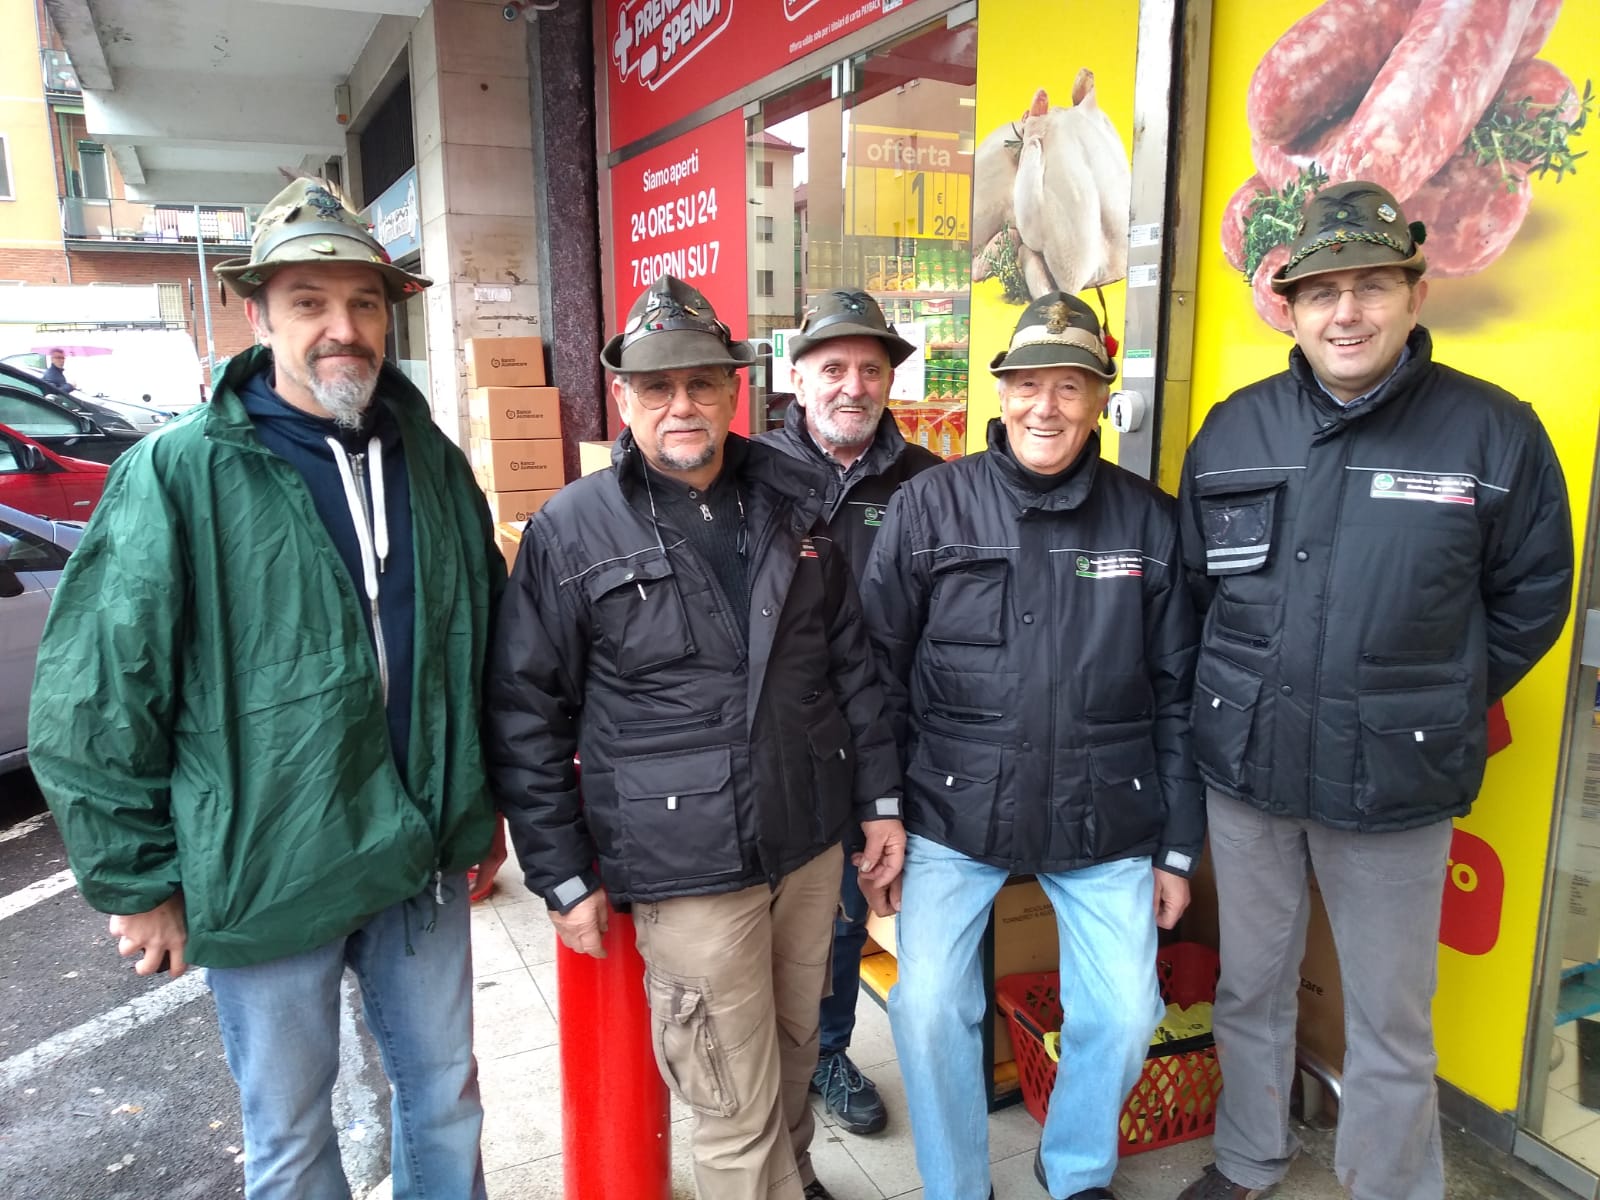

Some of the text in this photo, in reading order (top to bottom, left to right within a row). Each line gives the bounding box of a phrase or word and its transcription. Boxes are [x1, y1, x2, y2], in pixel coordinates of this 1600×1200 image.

[643, 148, 699, 193] Siamo aperti
[866, 138, 952, 168] offerta
[631, 187, 718, 243] 24 ORE SU 24
[910, 171, 926, 236] 1
[933, 214, 958, 238] 29
[631, 240, 720, 288] 7 GIORNI SU 7
